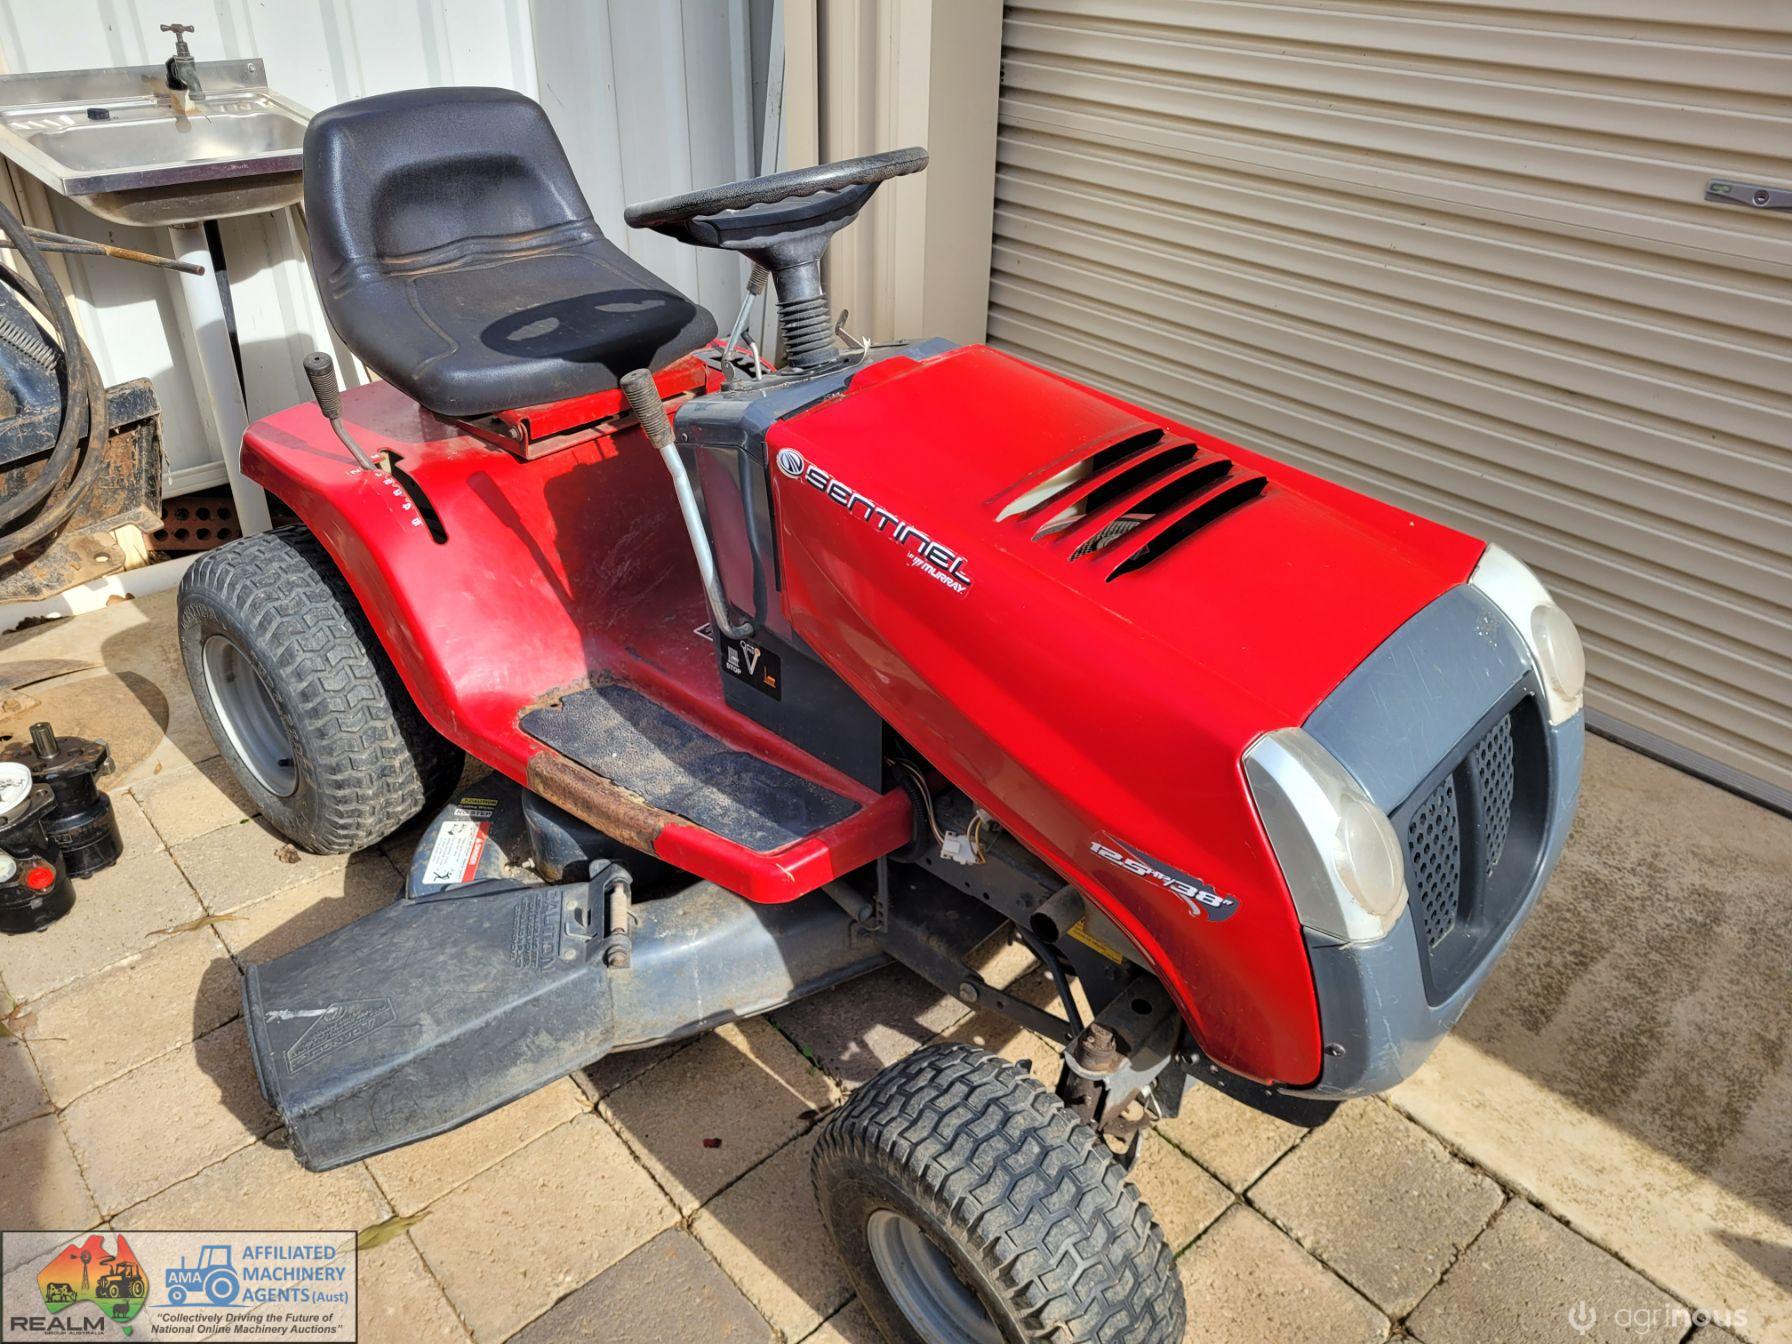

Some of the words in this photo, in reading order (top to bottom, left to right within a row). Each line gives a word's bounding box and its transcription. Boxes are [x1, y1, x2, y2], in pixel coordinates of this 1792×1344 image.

[804, 463, 972, 587] SENTINEL
[921, 562, 967, 593] MURRAY
[725, 661, 742, 676] STOP
